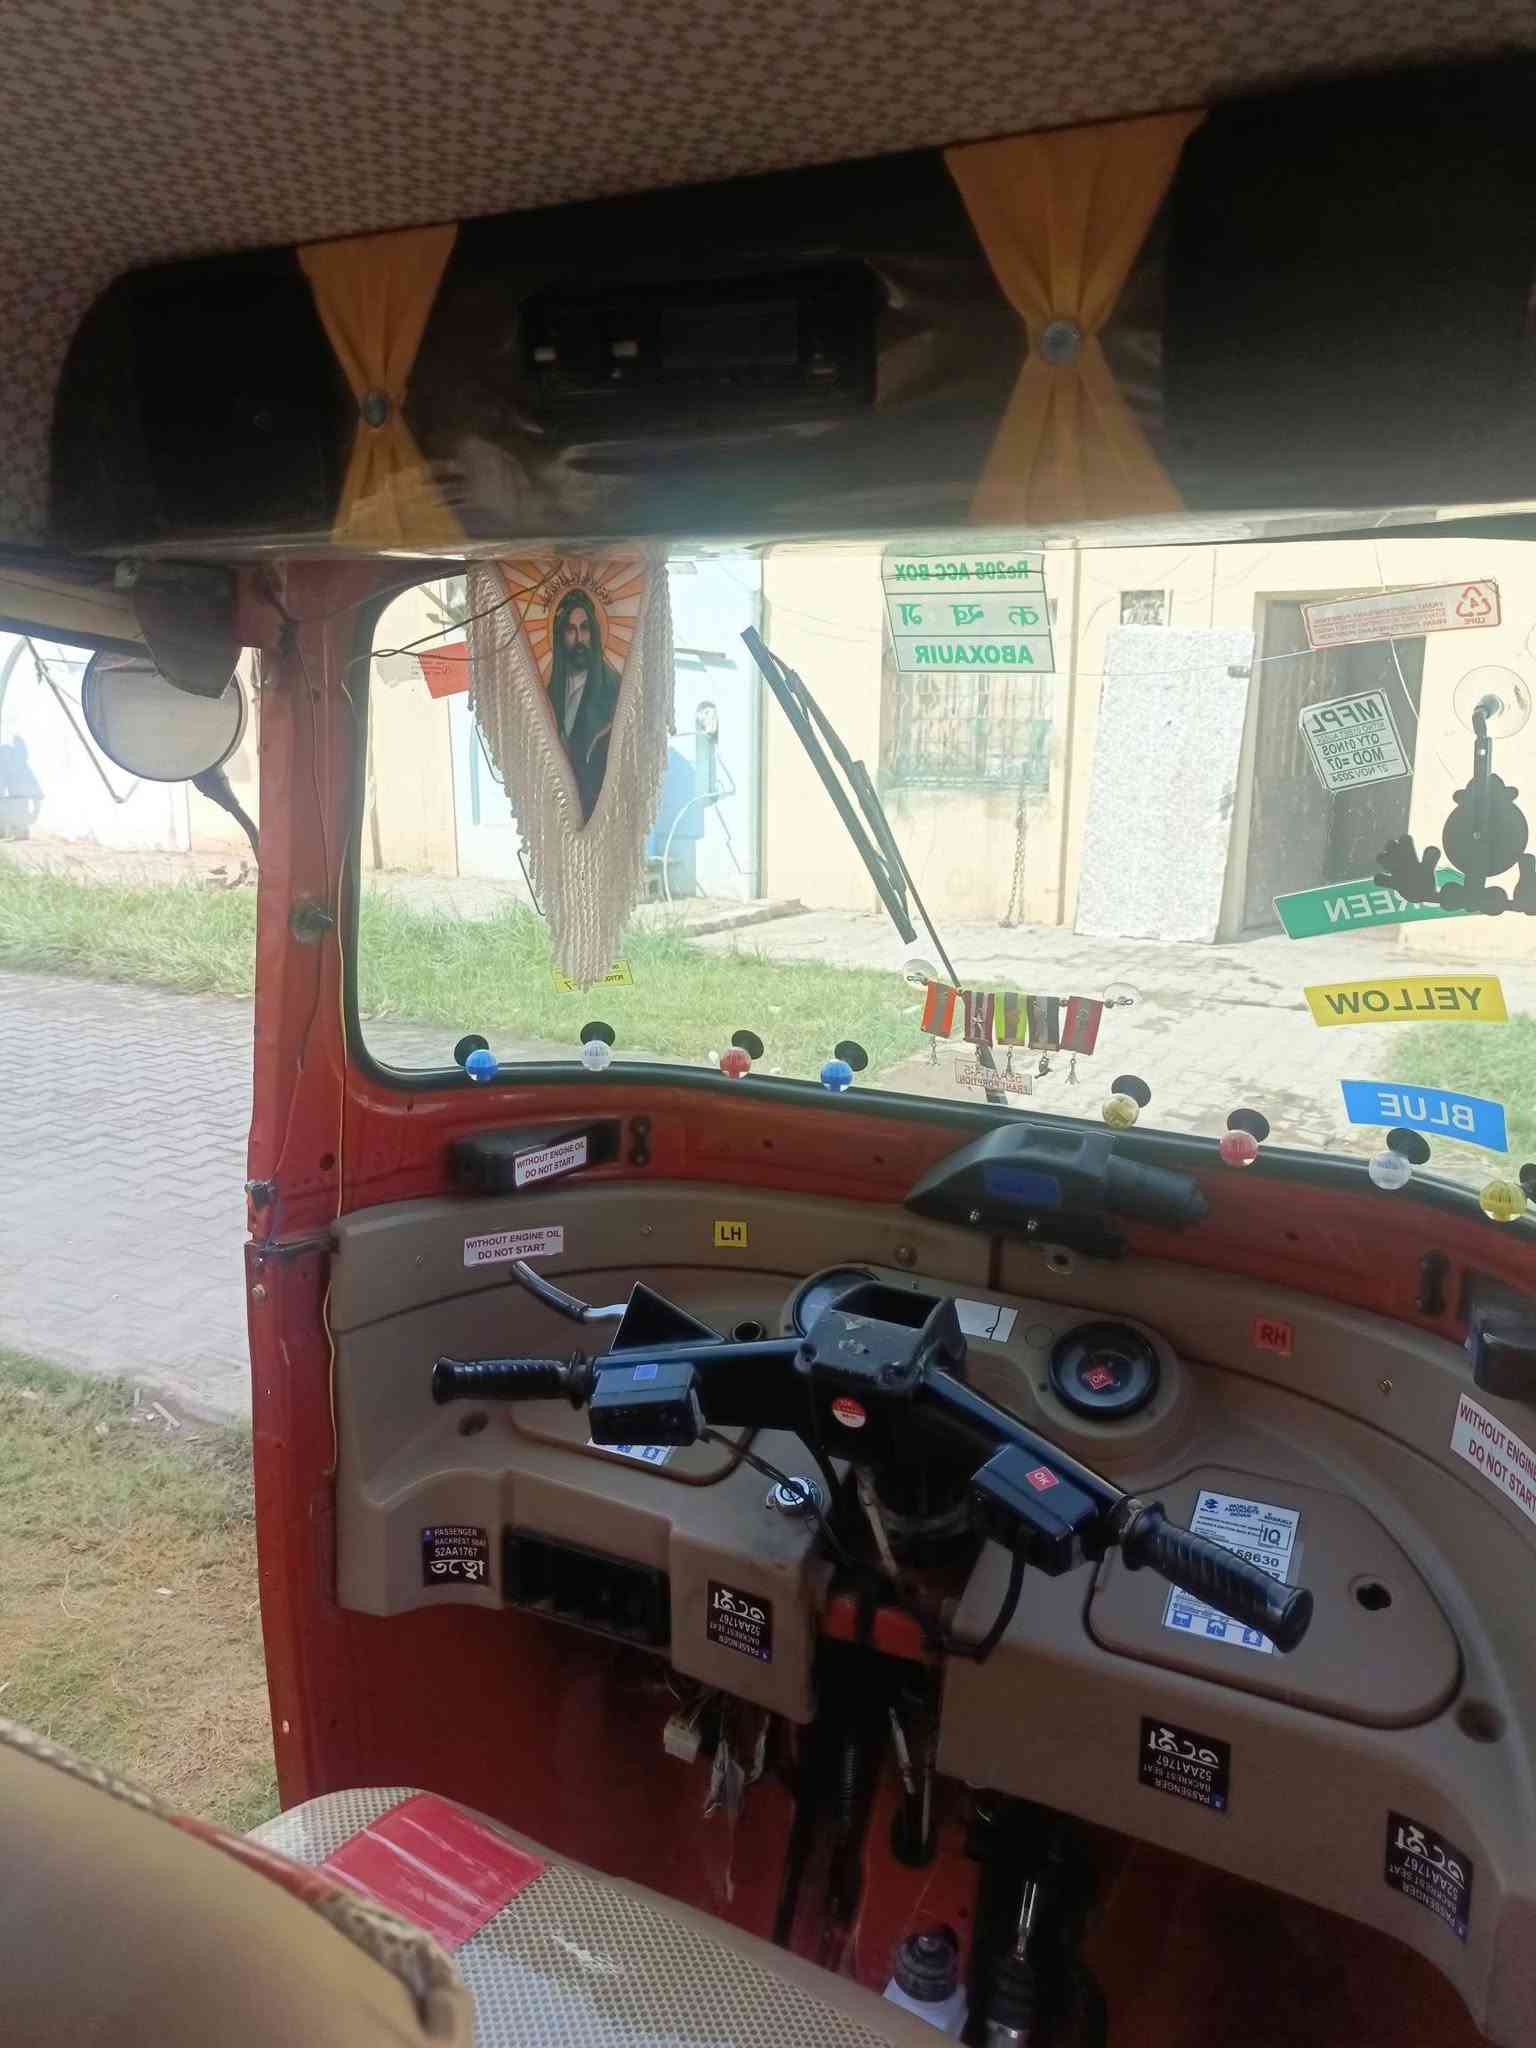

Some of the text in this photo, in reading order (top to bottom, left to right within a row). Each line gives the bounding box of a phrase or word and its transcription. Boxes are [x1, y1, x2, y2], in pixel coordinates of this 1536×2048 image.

[516, 1141, 585, 1169] WITHOUT ENGINE OIL
[525, 1156, 575, 1179] DO NOT START
[465, 1230, 561, 1249] WITHOUT ENGINE OIL
[720, 1225, 742, 1241] LH
[478, 1243, 546, 1260] DO NOT START
[1259, 1327, 1288, 1346] RH
[1460, 1401, 1506, 1449] WITHOUT
[1468, 1439, 1485, 1461] DO
[1486, 1452, 1508, 1482] NOT
[1262, 1527, 1281, 1545] IQ
[1156, 1754, 1212, 1782] 52AA1767
[1155, 1777, 1210, 1804] PASSENGER
[1404, 1855, 1458, 1901] 52AA1767
[1402, 1884, 1456, 1927] PASSENGER
